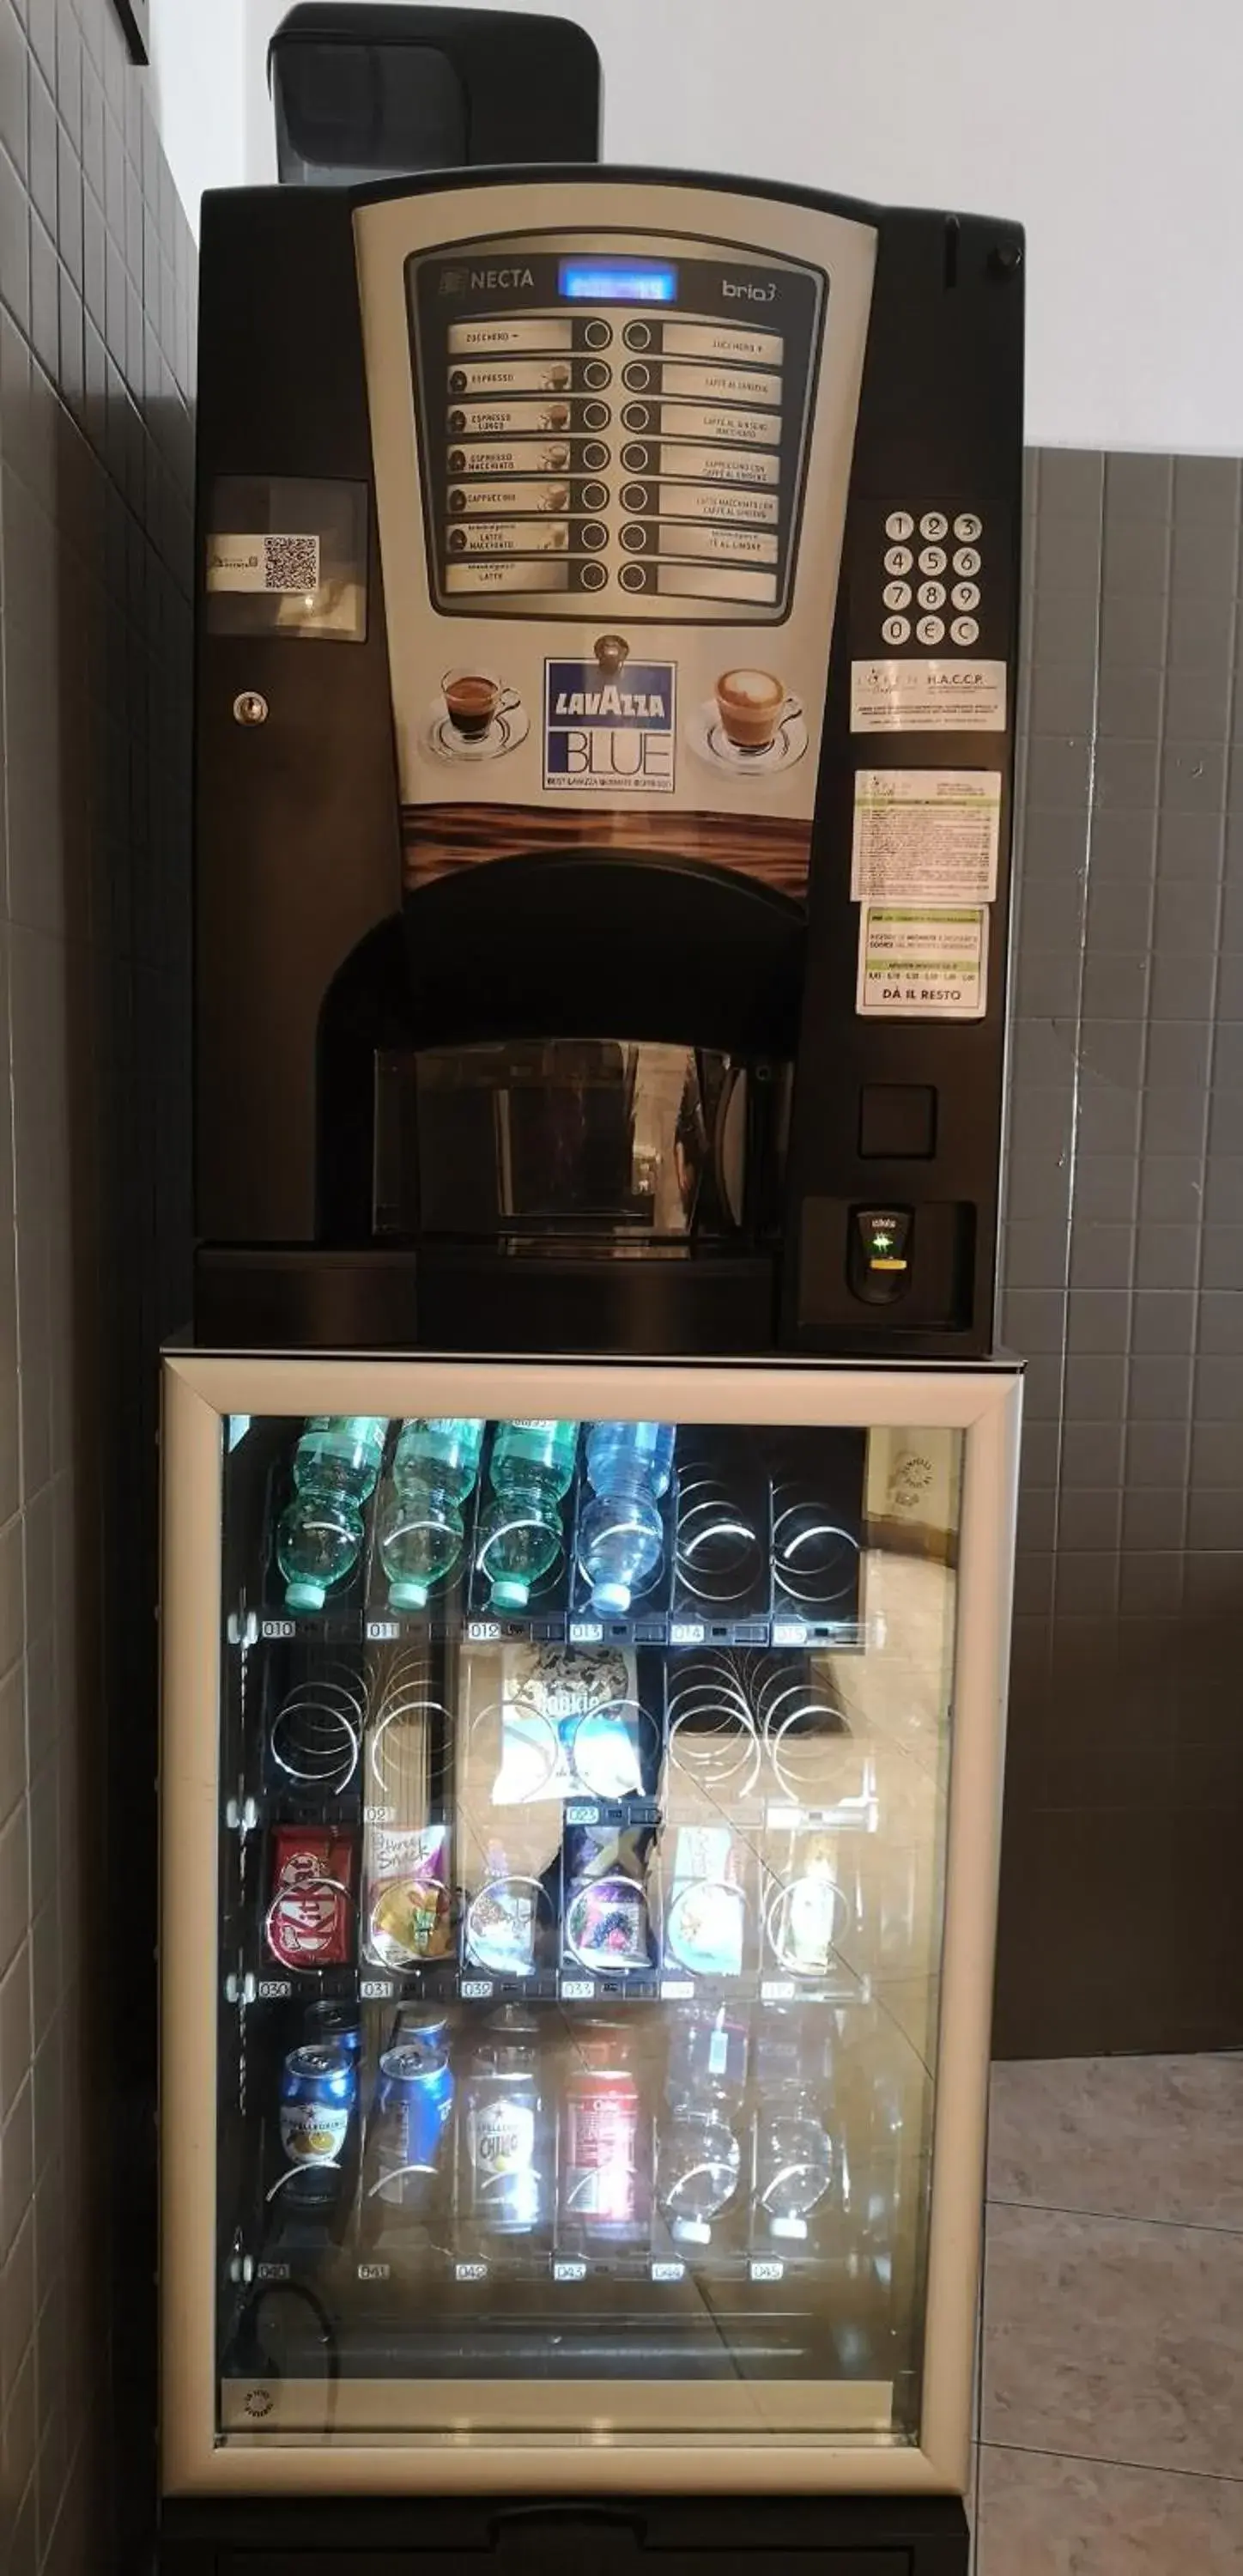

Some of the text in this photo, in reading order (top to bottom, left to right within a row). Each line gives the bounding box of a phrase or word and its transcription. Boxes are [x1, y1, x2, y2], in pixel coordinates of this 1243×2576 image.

[471, 269, 534, 289] NECTA
[471, 374, 513, 382] ESPRESSO
[471, 414, 511, 423] ESPRESSO
[468, 462, 514, 471] MACCHIATO
[895, 518, 974, 537] 1 2 3
[480, 533, 502, 542] LATTE
[470, 541, 514, 550] MACCHIATO
[892, 552, 973, 570] 4 5 6
[479, 572, 503, 581] LATTE
[892, 586, 972, 605] 7 8 9
[889, 622, 902, 639] 0
[958, 623, 969, 640] C
[927, 674, 983, 685] H.A.C.C.P.
[555, 685, 665, 719] LAVAZZA
[549, 731, 672, 777] BLUE
[906, 990, 915, 999] IL
[920, 990, 961, 1001] RESTO
[263, 1622, 293, 1636] 010
[369, 1623, 397, 1637] 011
[470, 1623, 500, 1637] 012
[573, 1624, 601, 1639] 013
[260, 1983, 289, 1996] 030
[363, 1983, 392, 1996] 031
